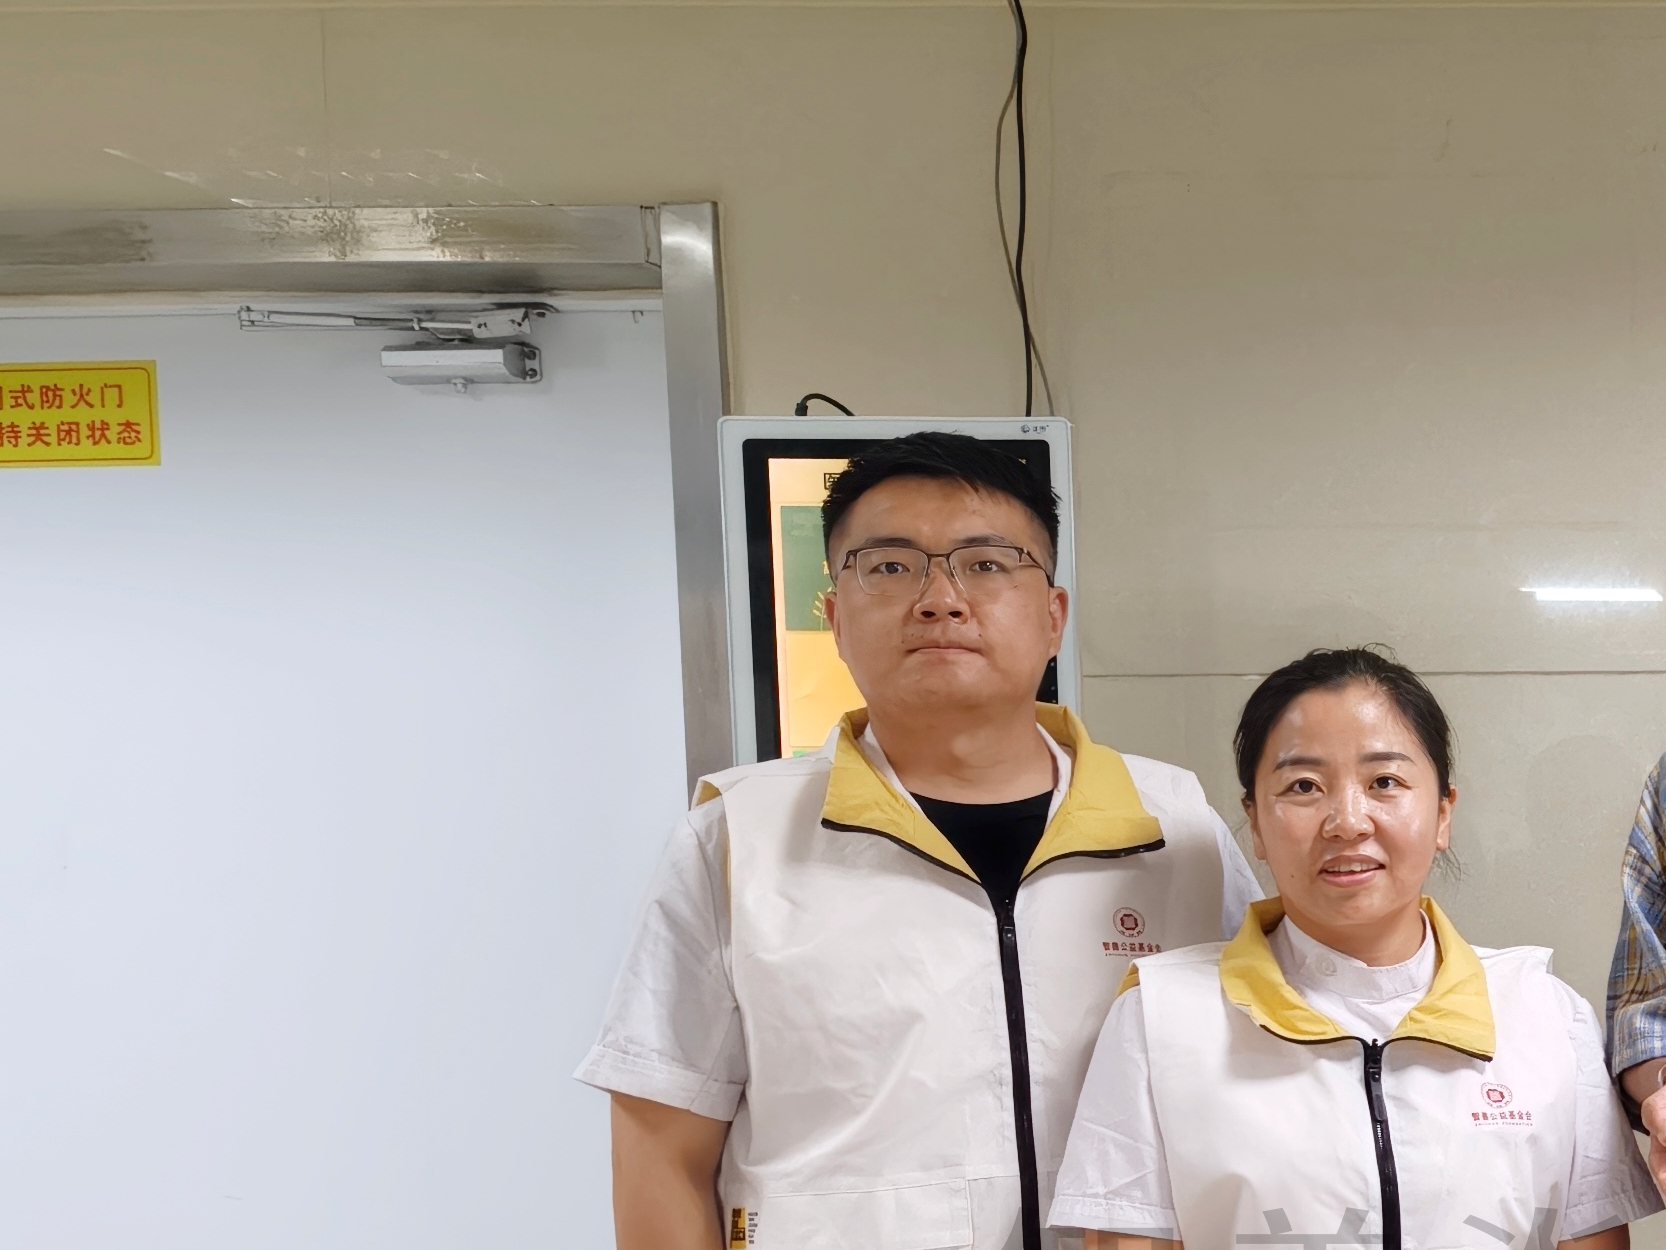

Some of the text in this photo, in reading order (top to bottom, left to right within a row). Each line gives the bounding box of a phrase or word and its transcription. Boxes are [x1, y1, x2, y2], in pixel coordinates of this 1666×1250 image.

[0, 383, 124, 411] 式防火门
[0, 420, 142, 448] 持关闭状态
